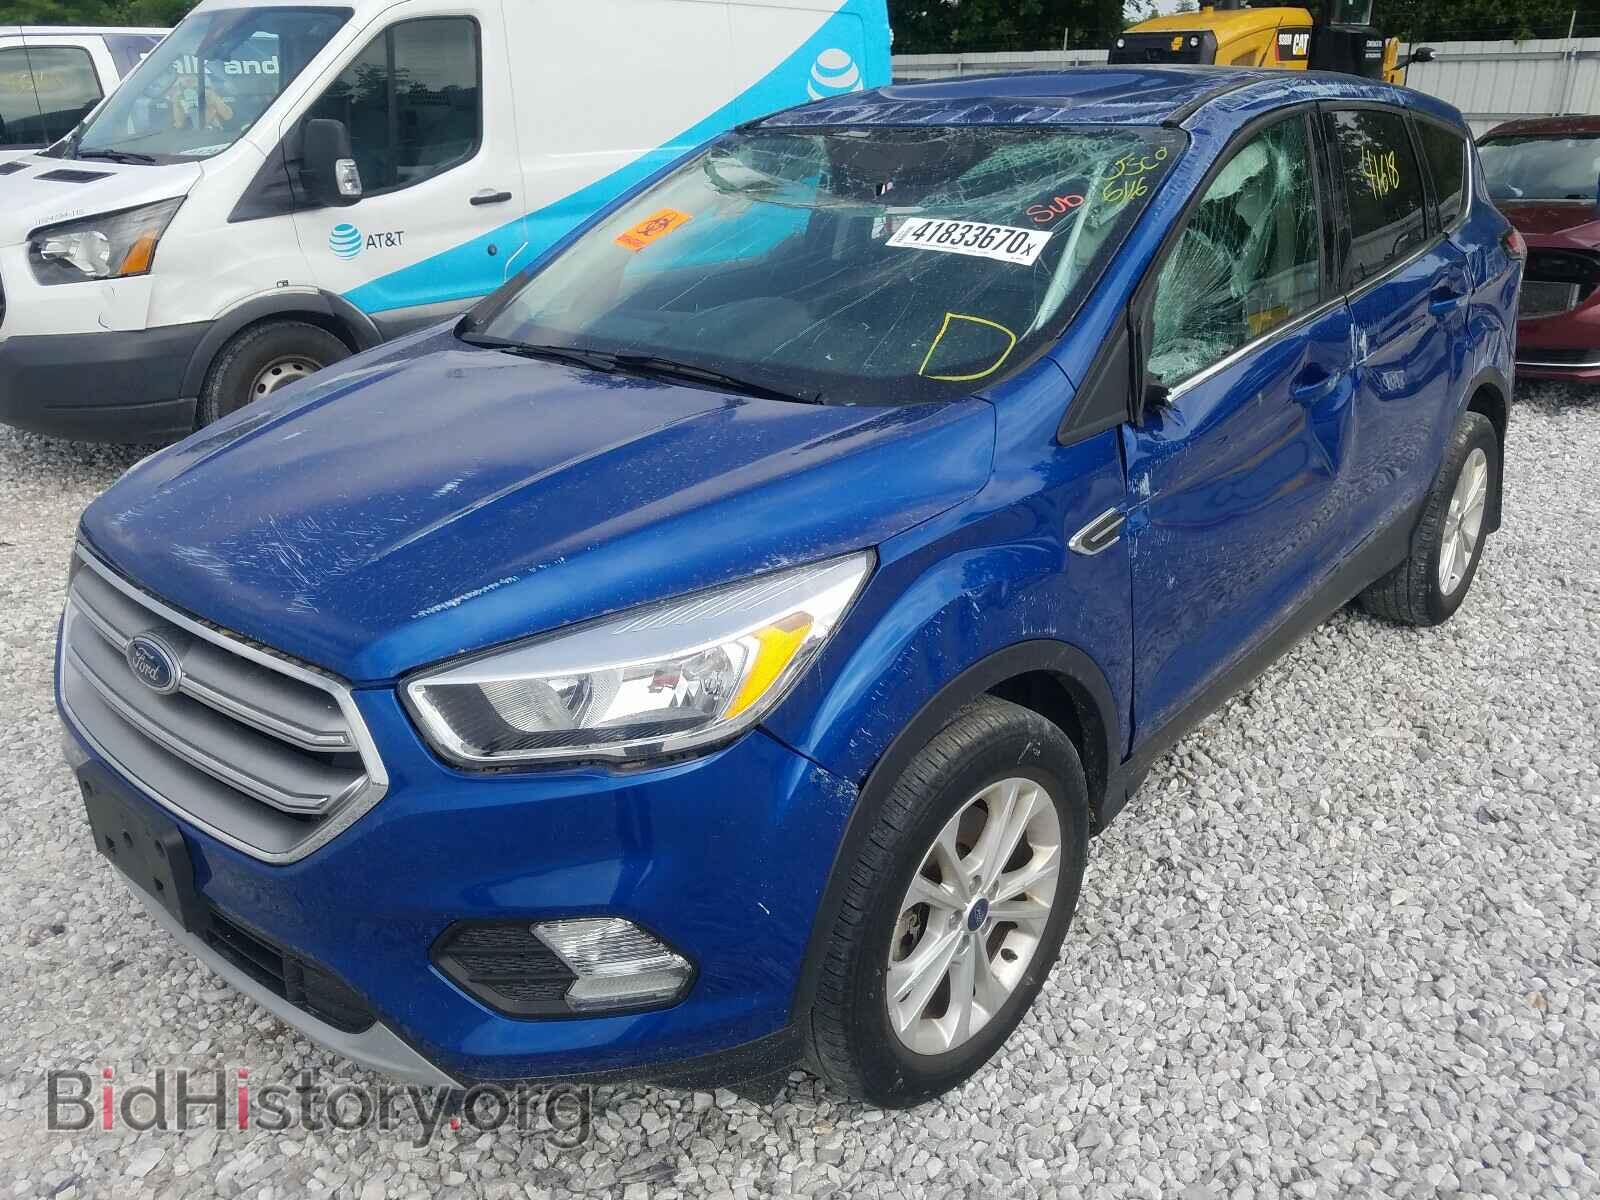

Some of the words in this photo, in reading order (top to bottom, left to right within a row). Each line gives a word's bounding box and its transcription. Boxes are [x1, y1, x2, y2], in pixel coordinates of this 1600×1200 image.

[1292, 33, 1310, 56] CAT
[224, 55, 280, 75] and
[366, 230, 405, 250] AT&T
[918, 312, 1017, 382] D
[132, 647, 161, 681] Ford
